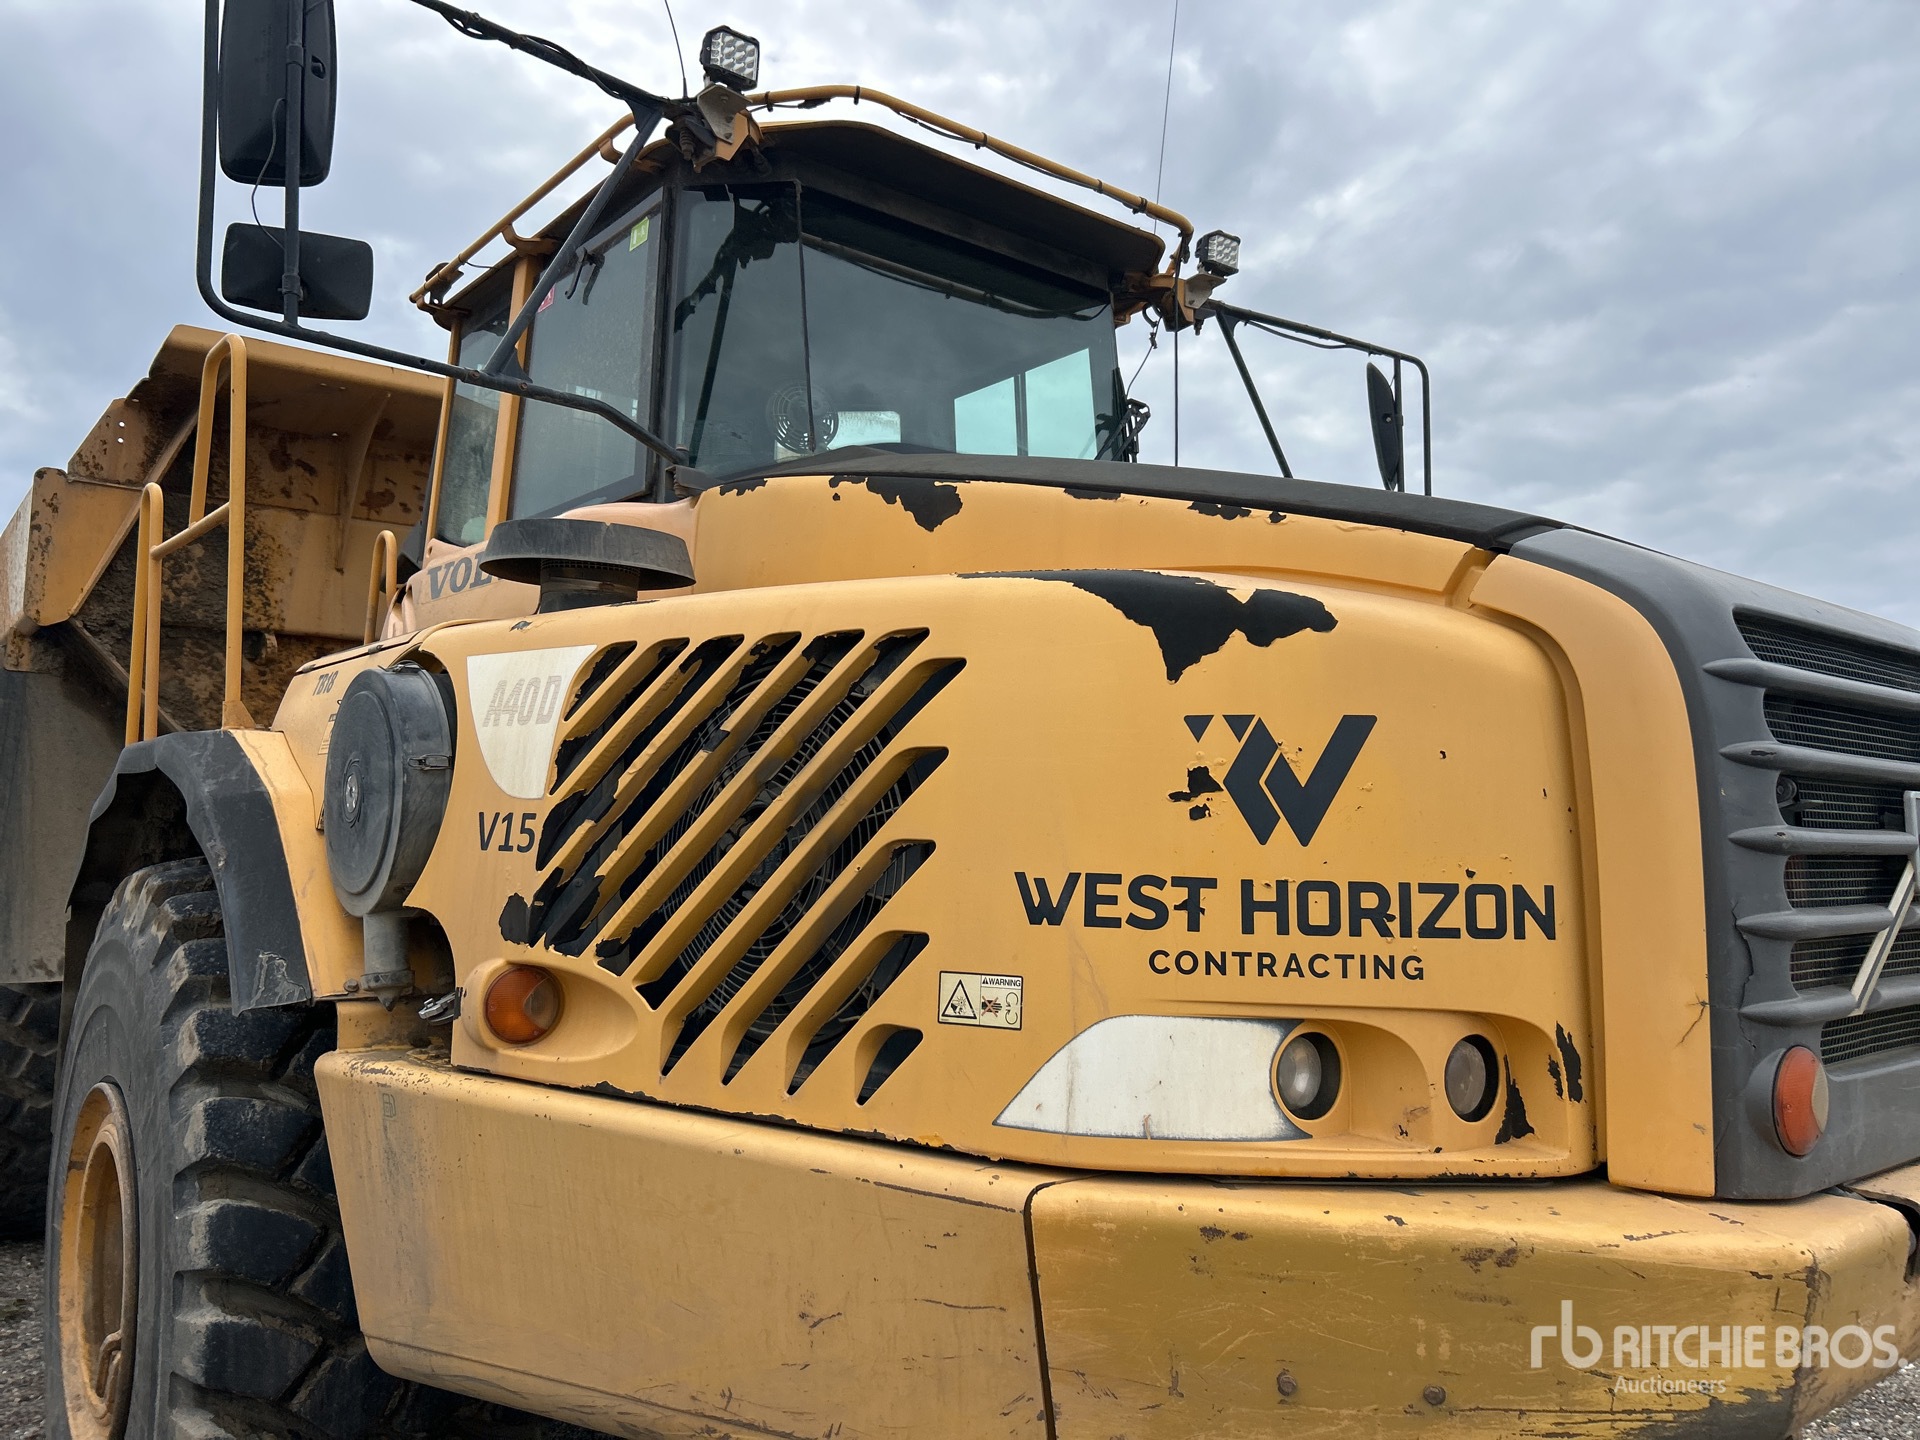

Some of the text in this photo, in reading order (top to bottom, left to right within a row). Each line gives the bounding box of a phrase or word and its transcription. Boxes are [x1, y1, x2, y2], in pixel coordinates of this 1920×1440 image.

[427, 551, 498, 600] VOL
[482, 675, 563, 728] A40D
[478, 811, 537, 853] V15
[1014, 871, 1556, 940] WEST HORIZON
[988, 978, 1021, 987] WARNING
[1148, 949, 1424, 980] CONTRACTING
